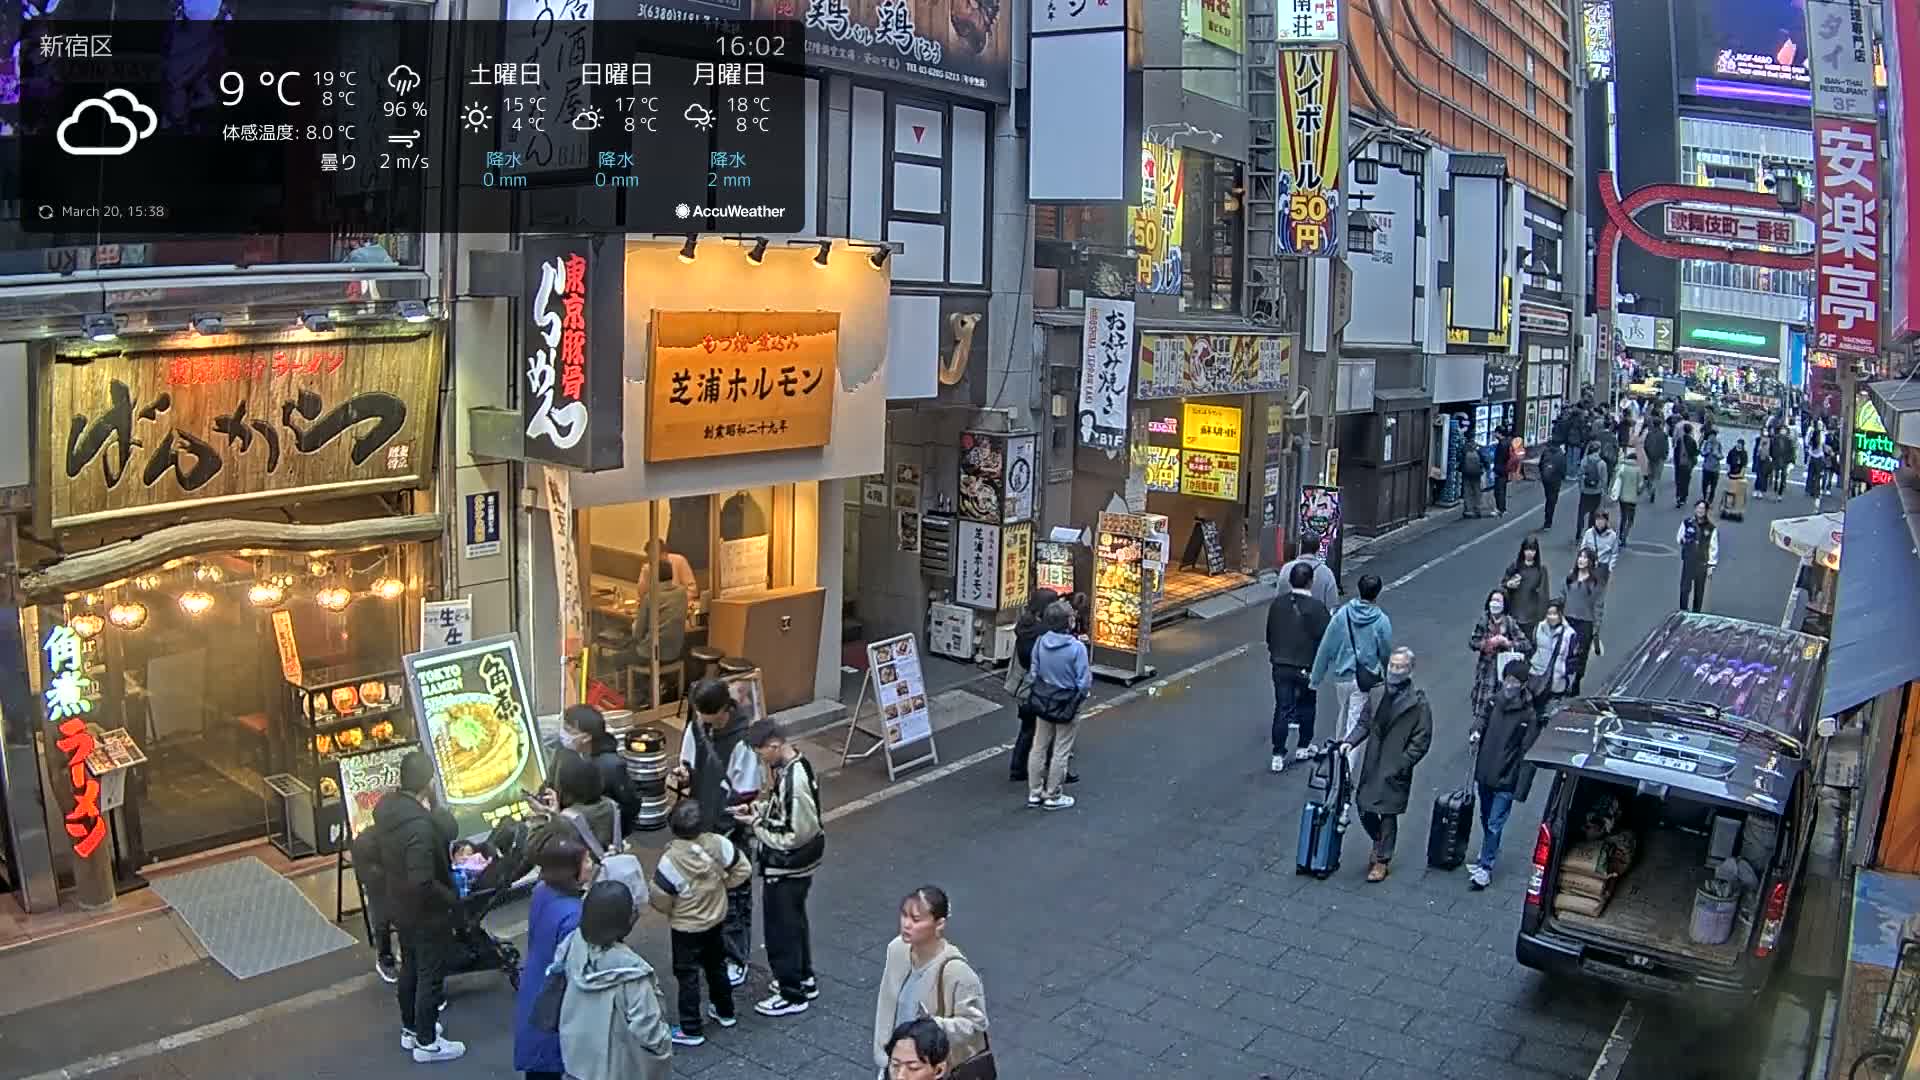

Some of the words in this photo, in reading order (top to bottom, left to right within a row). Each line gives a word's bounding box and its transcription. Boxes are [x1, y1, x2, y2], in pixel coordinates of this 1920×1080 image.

[1296, 53, 1322, 190] ハイボール
[1831, 97, 1854, 110] 3F
[1290, 194, 1327, 221] 50
[1296, 223, 1320, 250] 円
[1670, 210, 1790, 243] 歌舞伎町一番街
[1819, 127, 1877, 329] 安楽亭
[561, 253, 587, 400] 東京豚骨
[1819, 332, 1836, 347] 2F
[1098, 309, 1129, 415] お好み焼き
[669, 365, 824, 406] 芝浦ホルモン
[66, 377, 408, 492] ばんから
[417, 664, 461, 685] TOKYO
